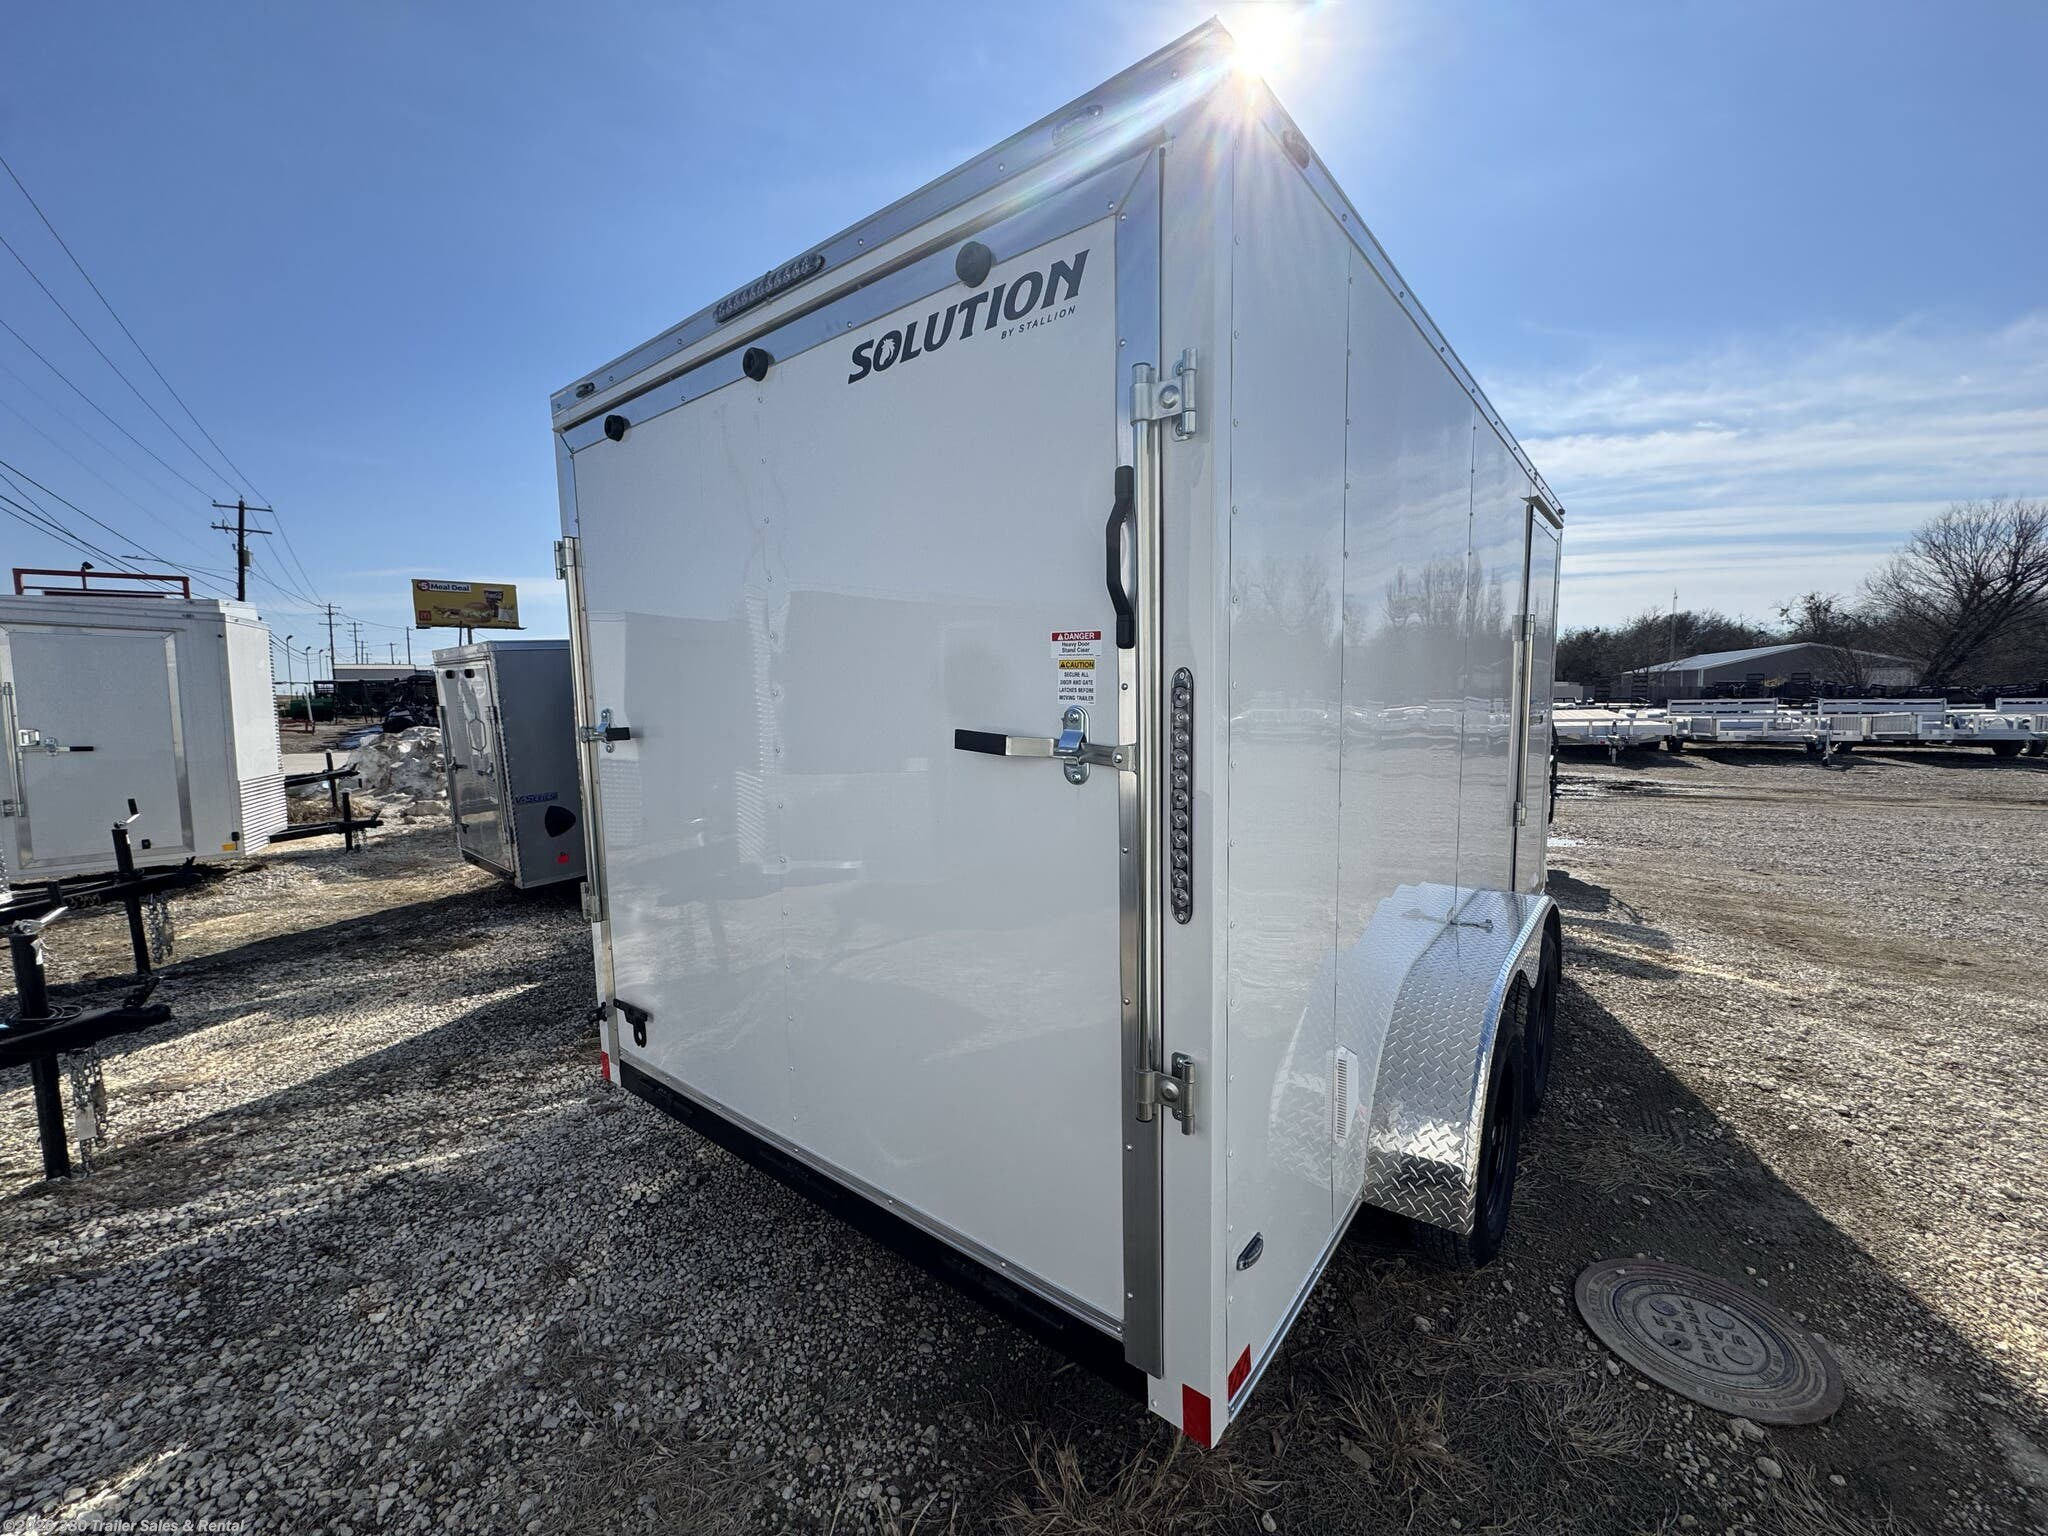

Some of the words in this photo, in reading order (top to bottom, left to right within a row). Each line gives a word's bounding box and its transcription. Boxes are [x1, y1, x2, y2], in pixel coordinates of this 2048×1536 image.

[848, 249, 1090, 384] SOLUTION
[1001, 328, 1014, 340] BY
[1018, 305, 1076, 333] STALLION
[1064, 632, 1095, 640] DANGER
[1652, 1315, 1748, 1347] WATER
